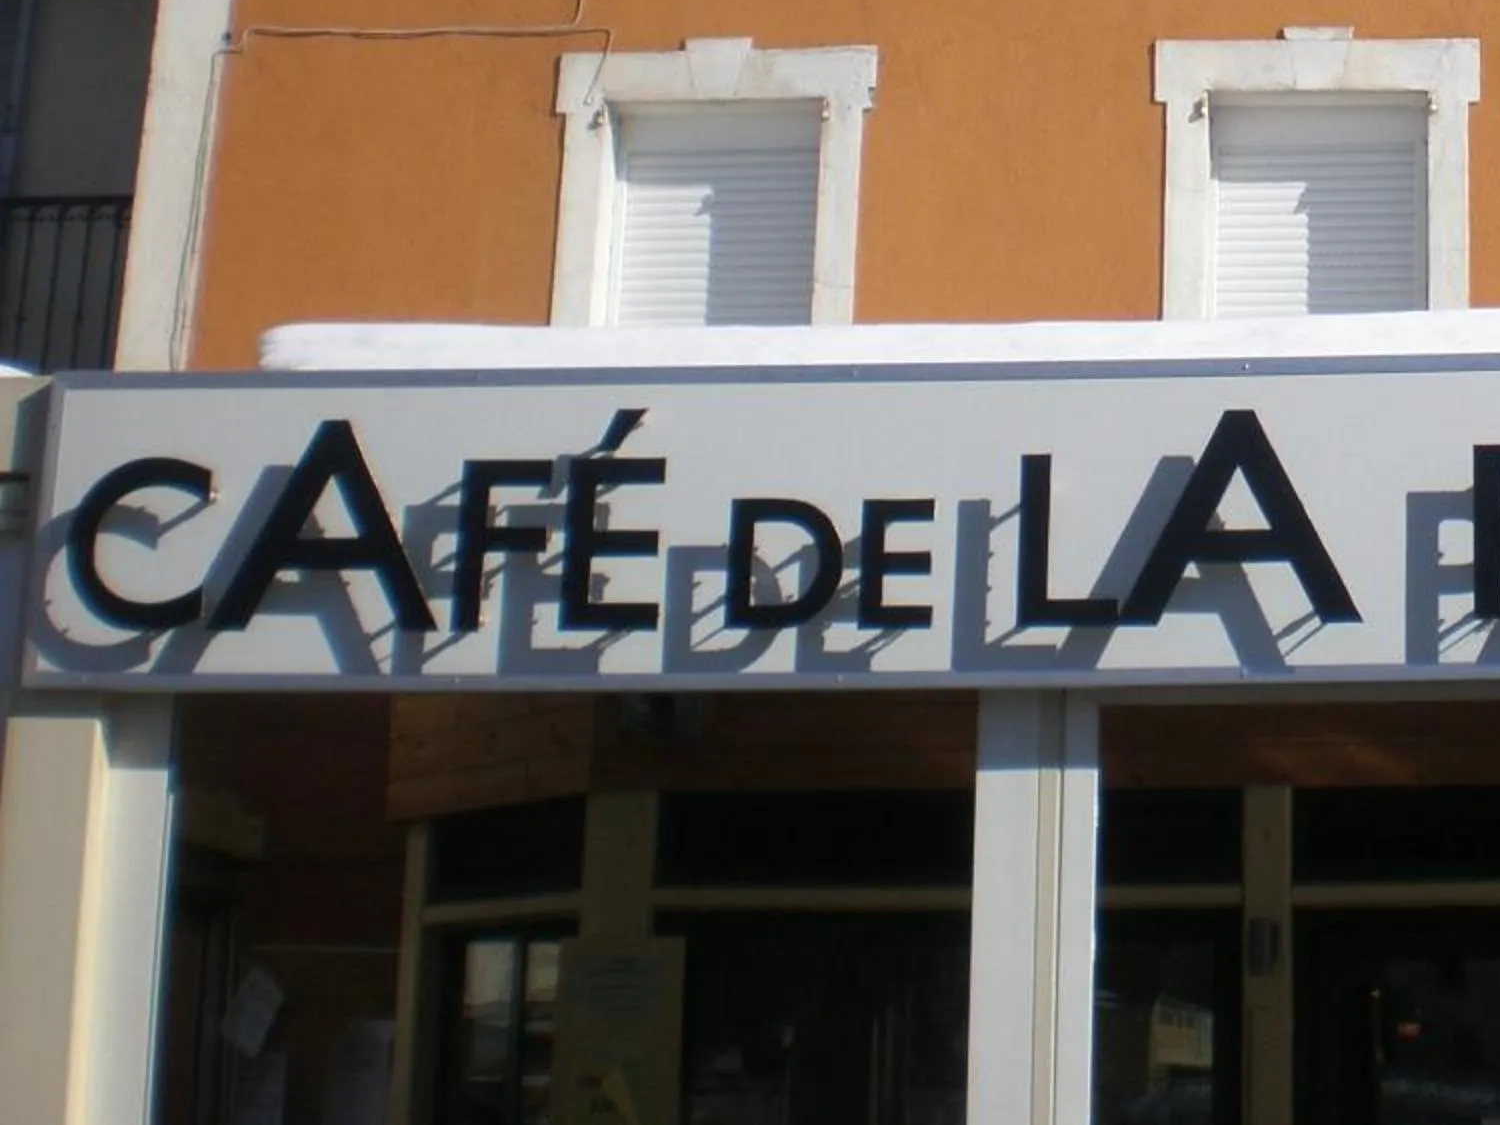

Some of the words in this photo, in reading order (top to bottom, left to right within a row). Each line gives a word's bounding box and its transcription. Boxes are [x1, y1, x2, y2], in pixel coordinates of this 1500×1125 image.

[66, 407, 667, 633] CAFÉ
[723, 497, 936, 631] DE
[1016, 408, 1363, 628] LA
